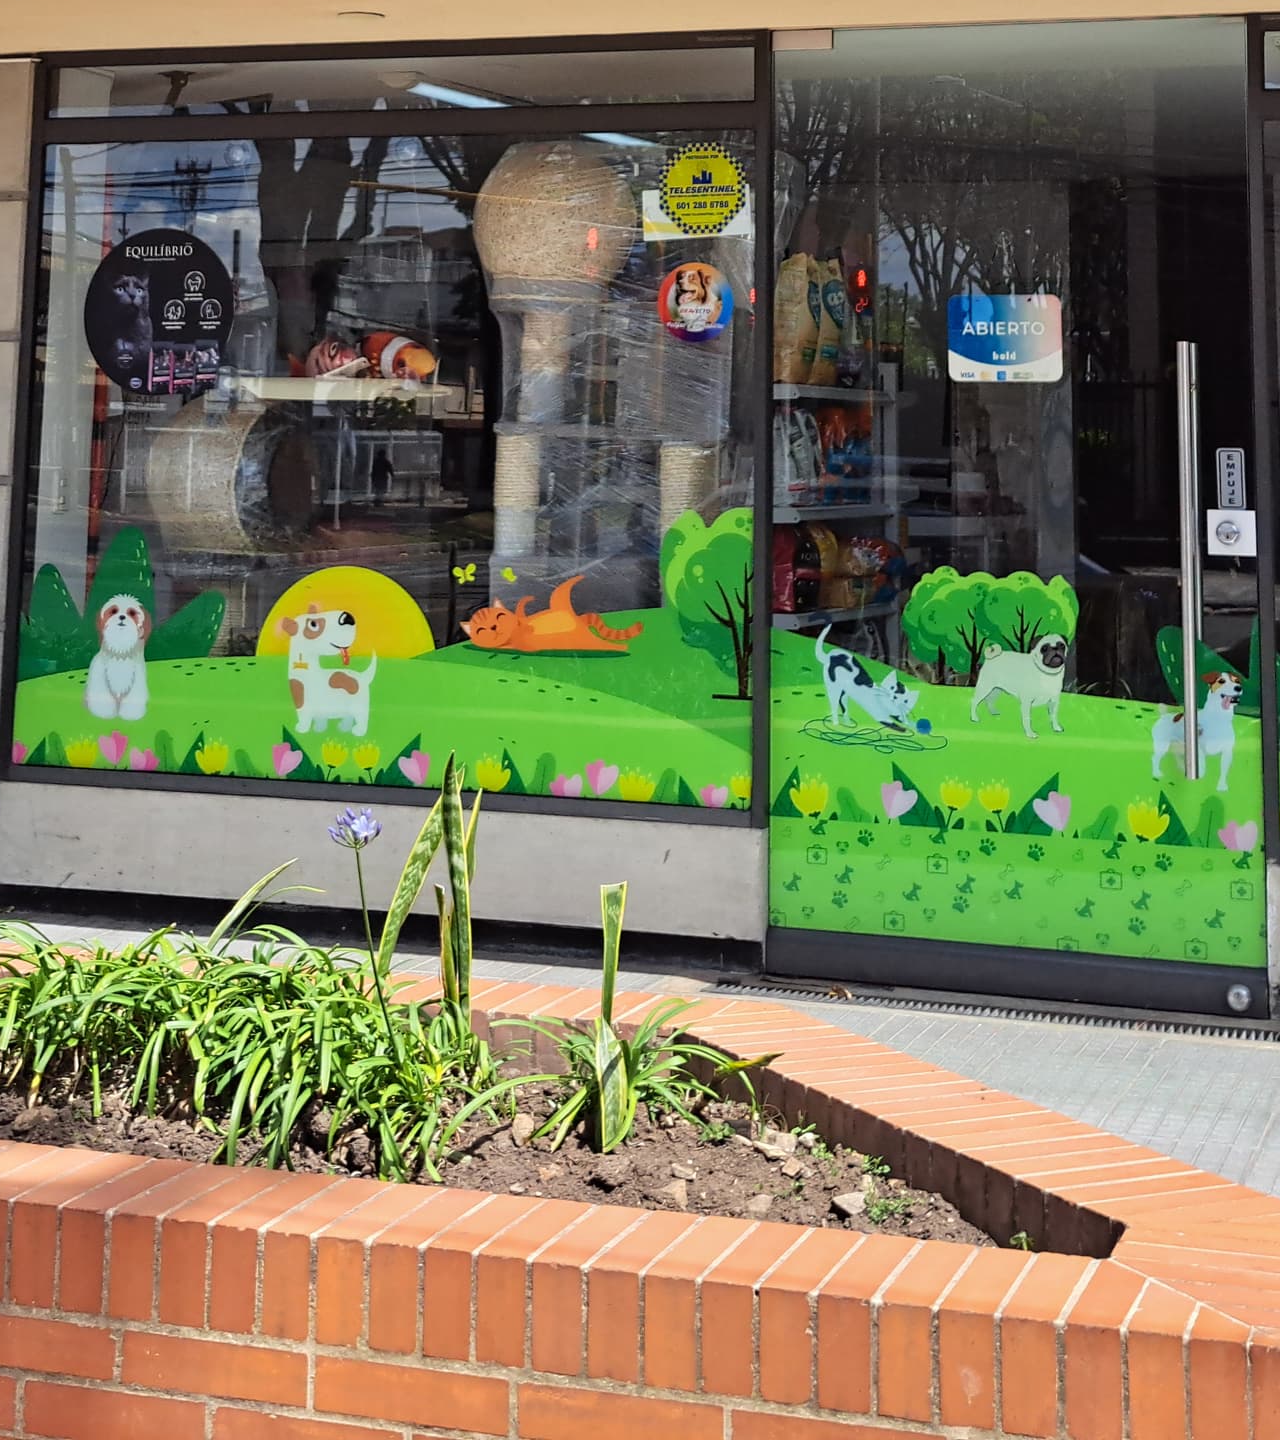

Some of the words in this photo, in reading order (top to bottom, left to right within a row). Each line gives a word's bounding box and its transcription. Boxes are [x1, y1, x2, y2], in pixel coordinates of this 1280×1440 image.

[669, 185, 736, 194] TELESENTINEL
[962, 321, 1046, 336] ABIERTO
[992, 351, 1017, 361] bold
[1226, 453, 1236, 505] EMPUJE
